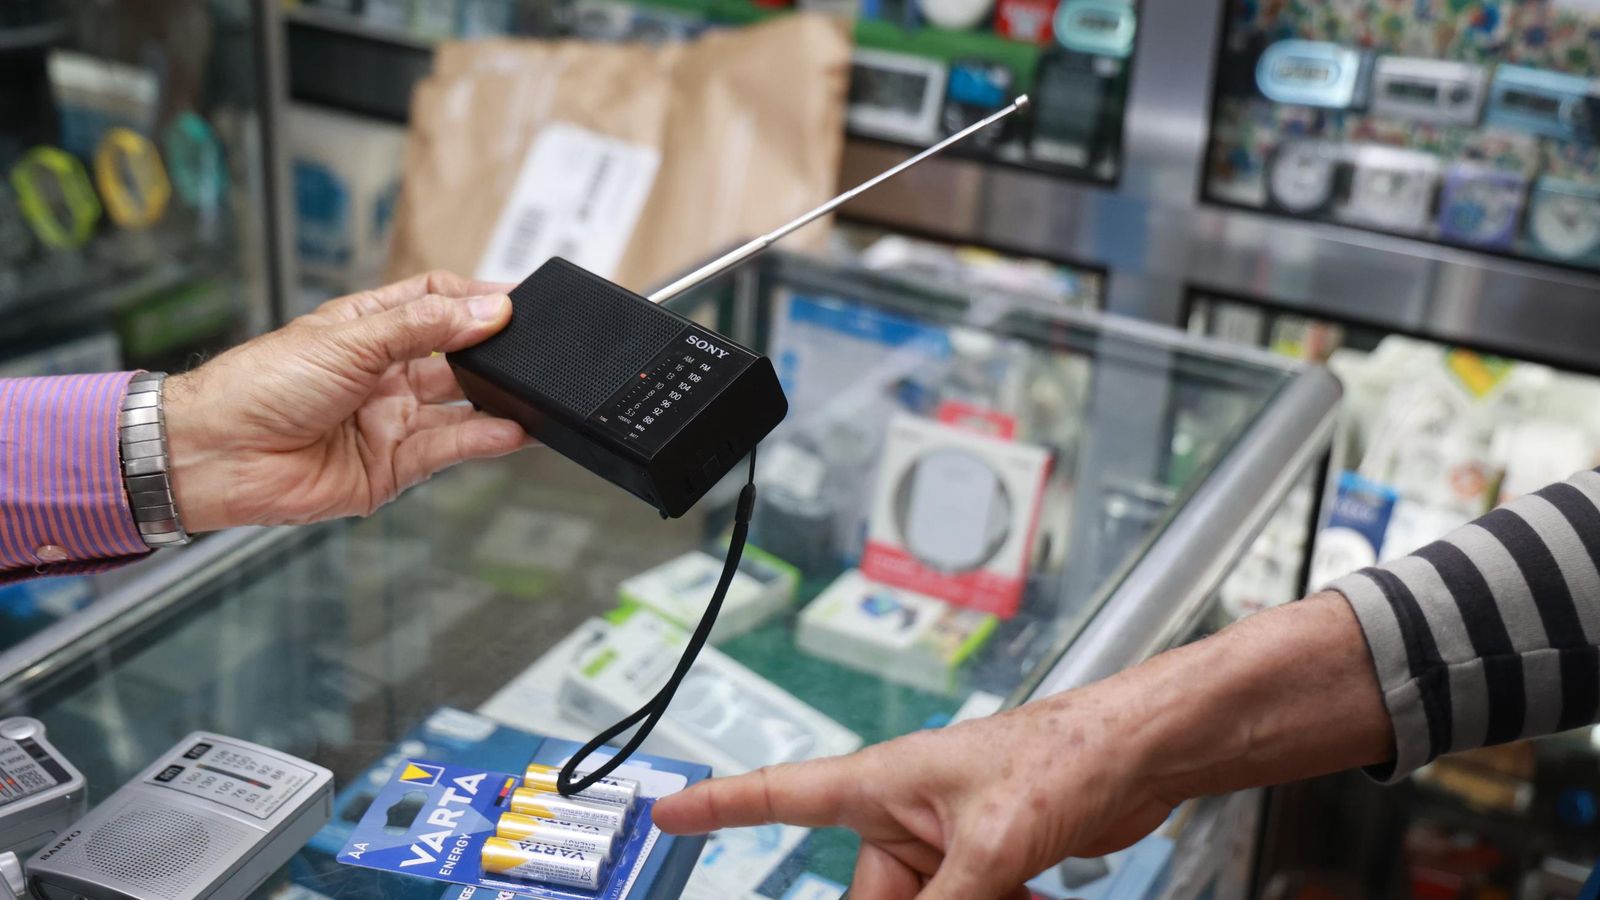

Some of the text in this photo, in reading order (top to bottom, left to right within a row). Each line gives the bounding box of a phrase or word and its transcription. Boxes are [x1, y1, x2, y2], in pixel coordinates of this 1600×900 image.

[685, 335, 730, 359] SONY
[675, 363, 702, 383] 16 108
[682, 355, 711, 372] AM FM
[666, 372, 692, 391] 13 104
[655, 382, 682, 401] 10 100
[652, 407, 664, 416] 92
[660, 399, 672, 408] 96
[642, 415, 655, 425] 88
[196, 775, 218, 789] 130
[213, 781, 235, 795] 100
[400, 773, 488, 867] VARTA
[40, 830, 81, 861] SANYO
[347, 842, 370, 859] AA
[439, 833, 472, 876] ENERGY
[519, 841, 585, 860] VARTA
